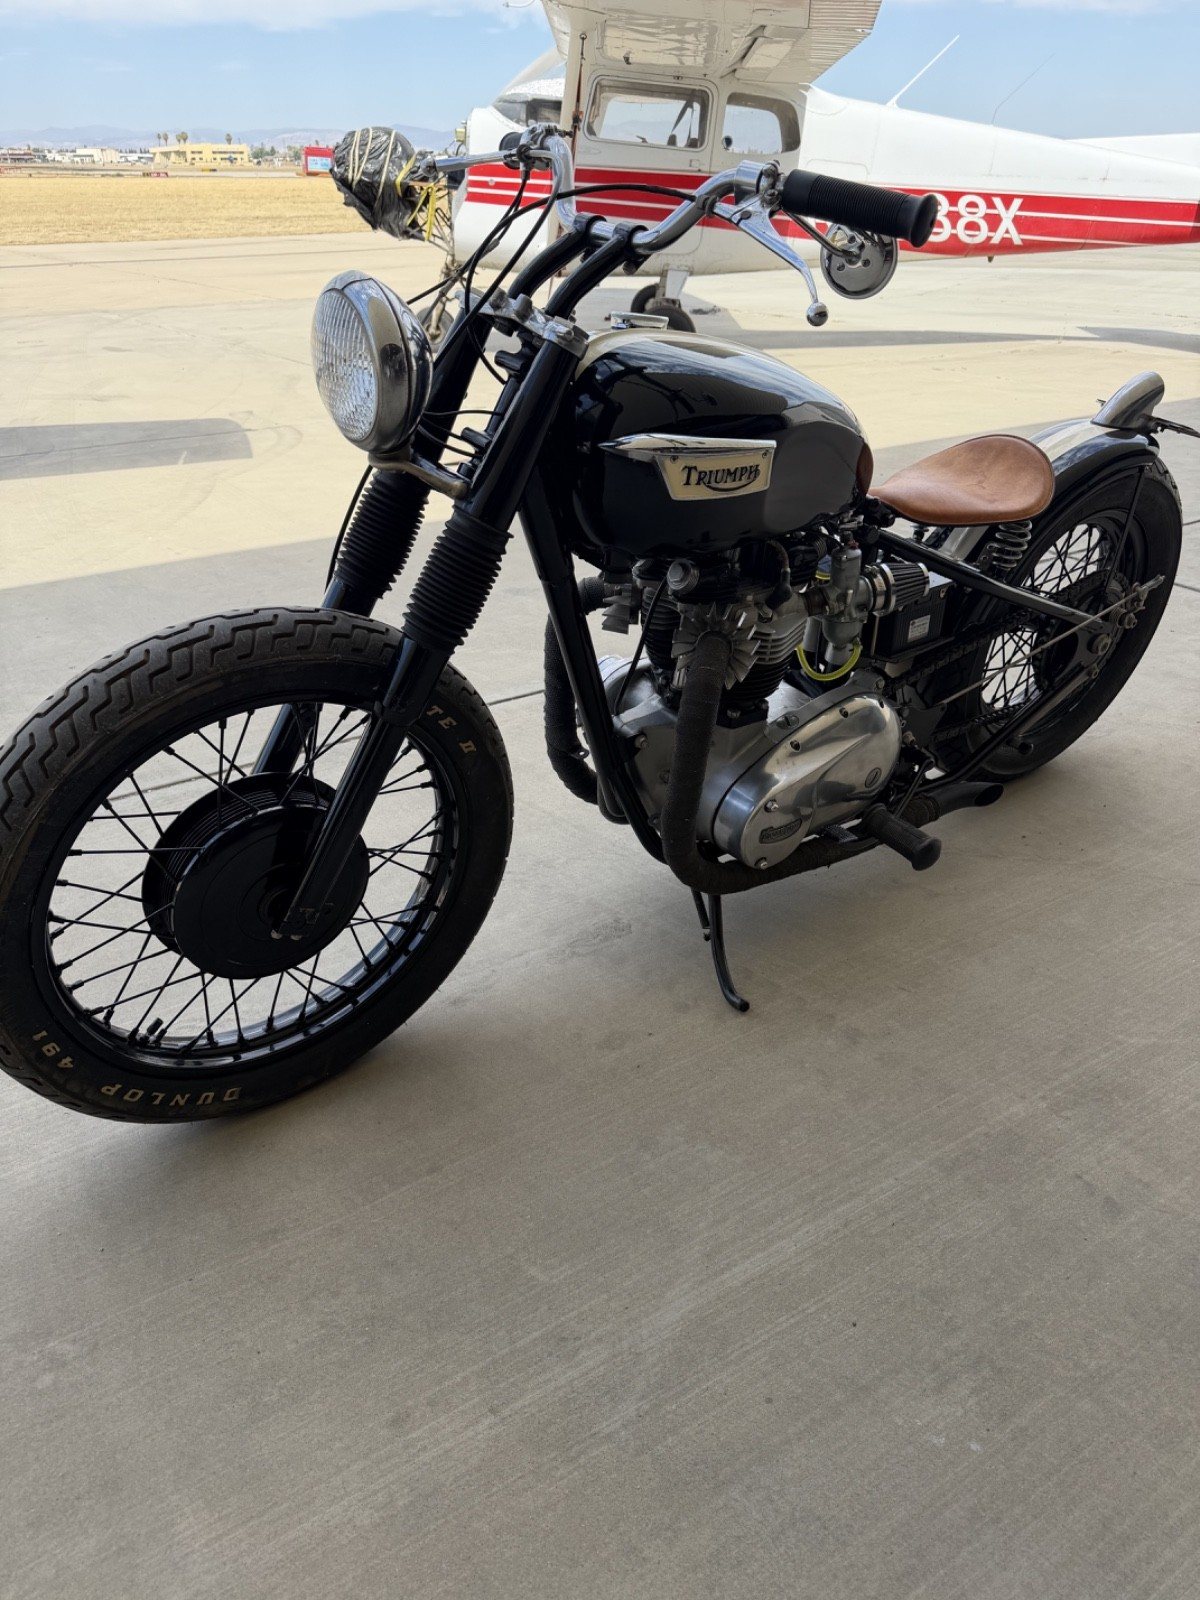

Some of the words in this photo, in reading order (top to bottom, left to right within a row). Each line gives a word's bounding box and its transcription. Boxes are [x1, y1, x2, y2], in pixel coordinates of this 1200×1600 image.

[681, 464, 761, 492] TRIUMPH
[32, 1030, 75, 1069] 491
[101, 1083, 243, 1106] DUNLOP
